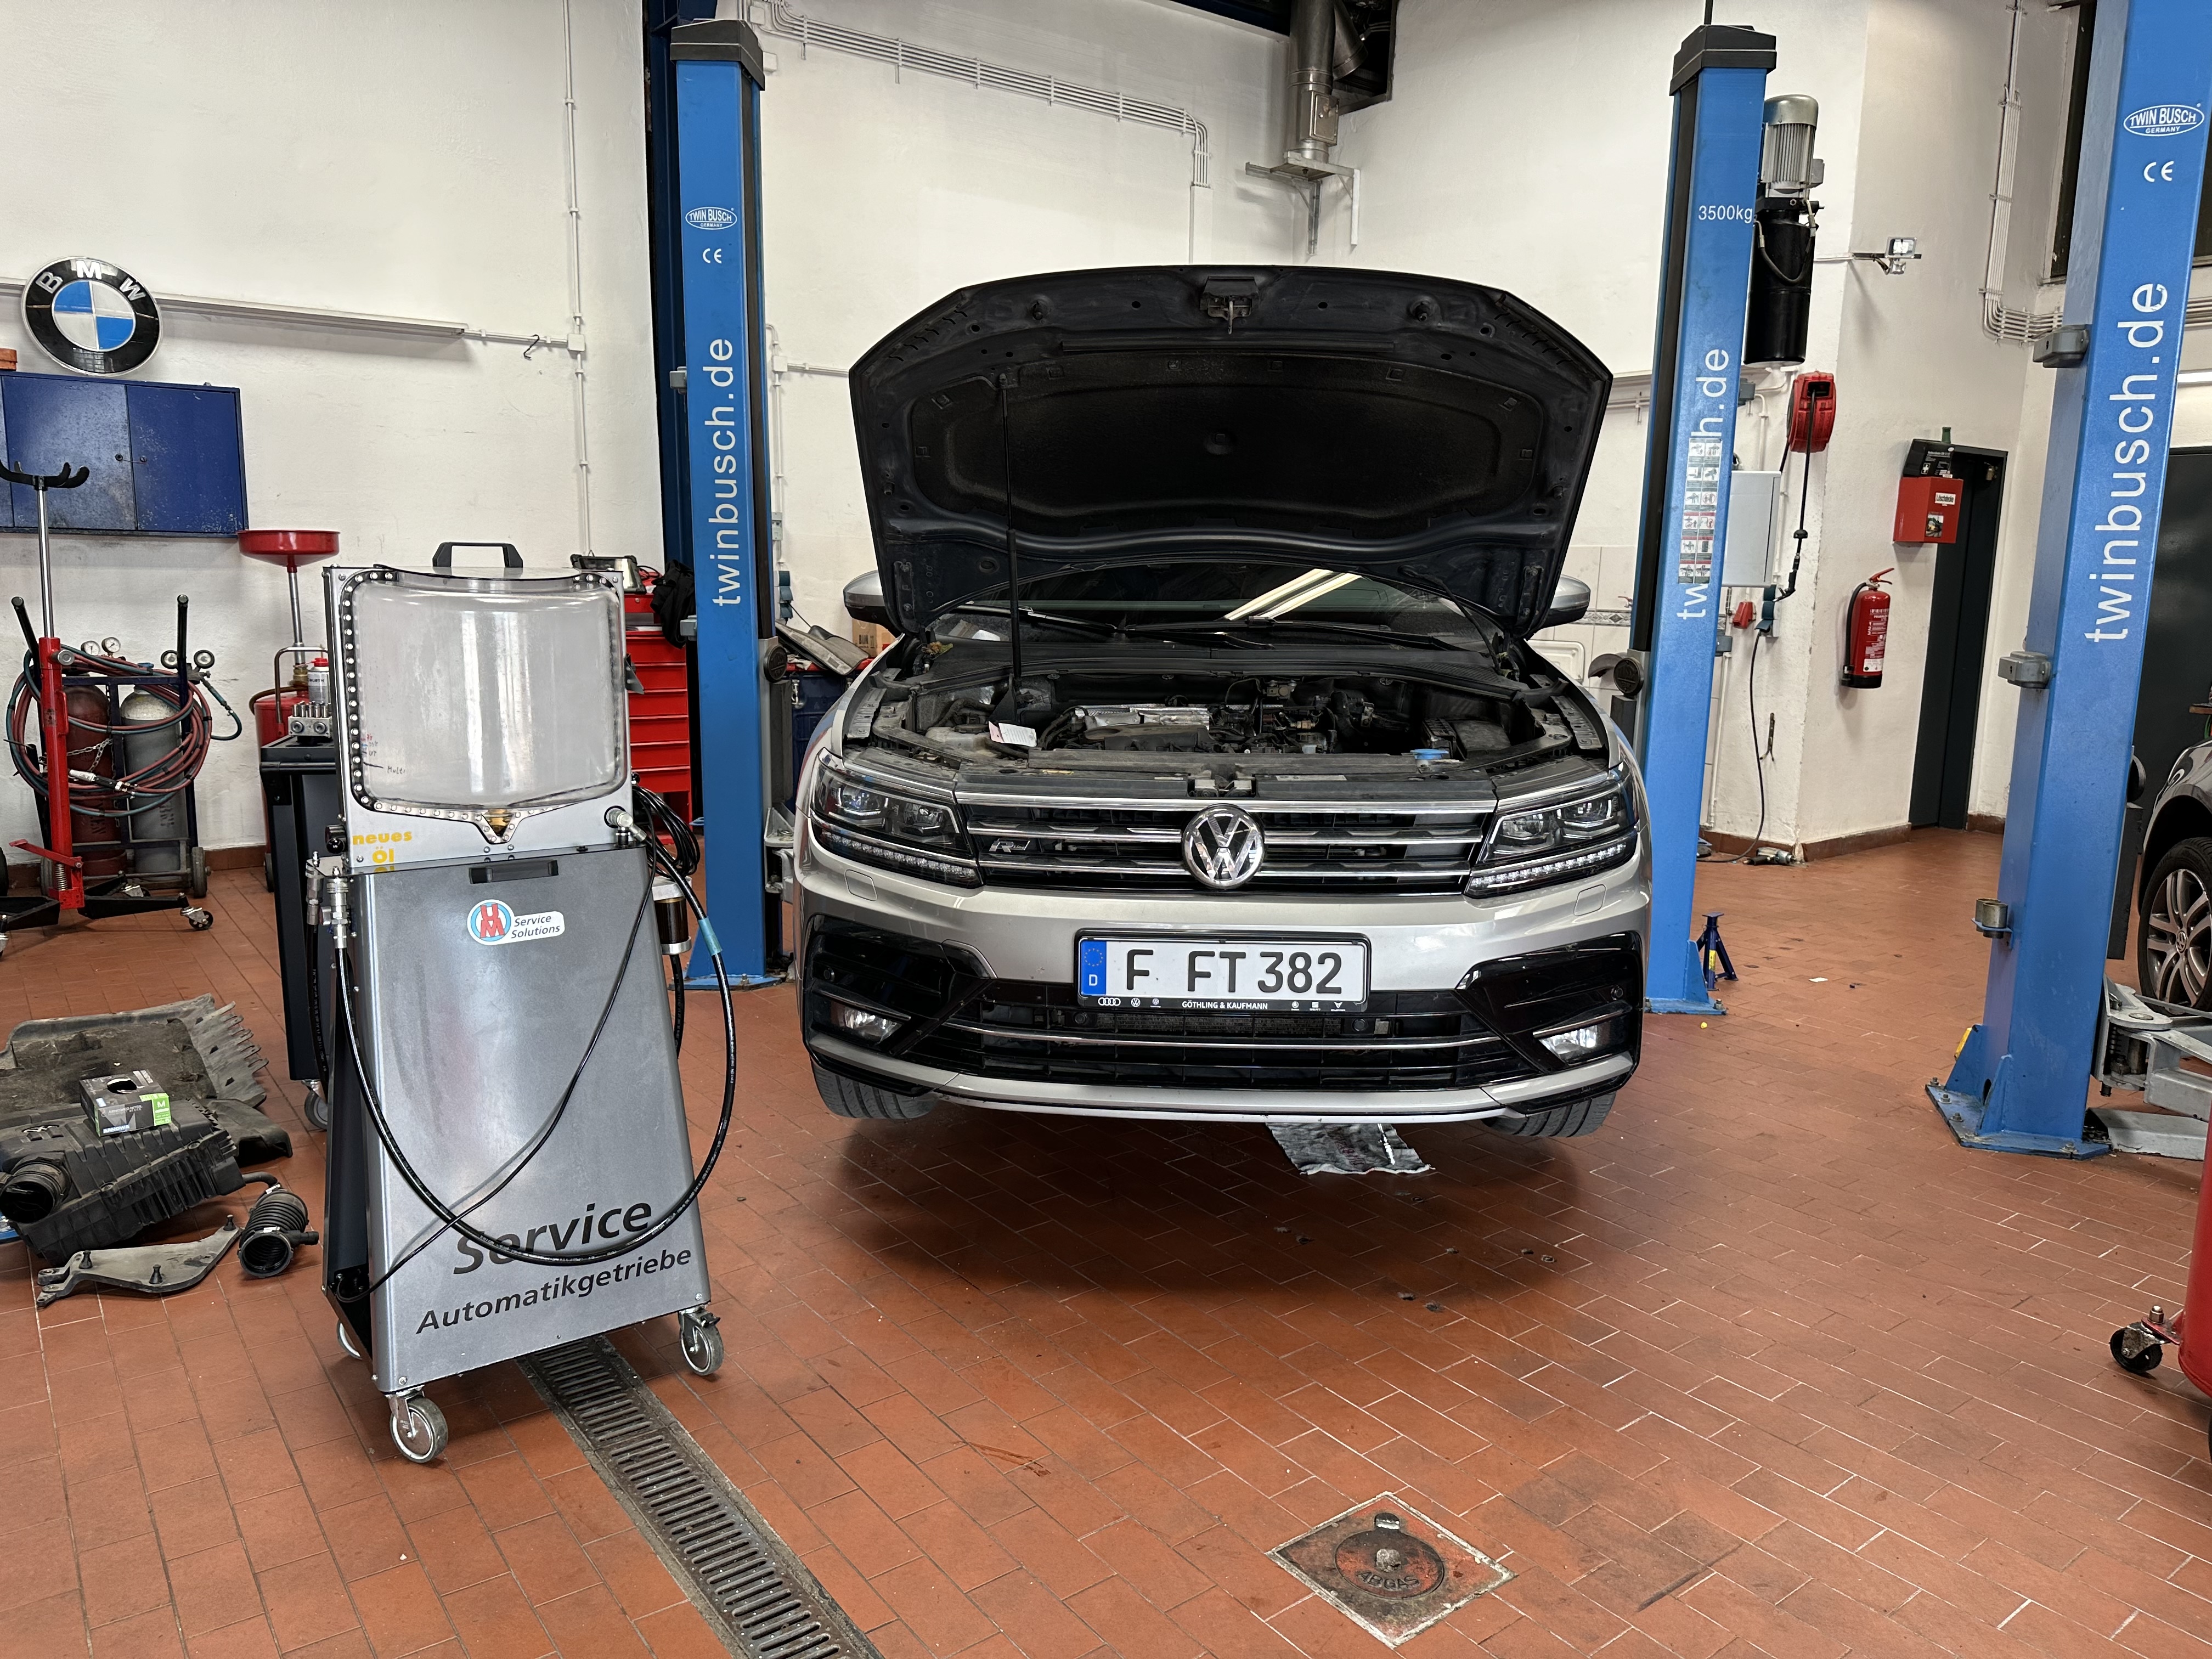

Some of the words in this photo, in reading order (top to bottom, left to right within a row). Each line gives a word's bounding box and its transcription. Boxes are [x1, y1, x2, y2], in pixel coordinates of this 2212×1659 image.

[2130, 109, 2157, 126] TWIN
[2159, 108, 2196, 124] BUSCH
[2143, 161, 2174, 183] CE
[689, 210, 706, 221] TWIN
[708, 209, 732, 221] BUSCH
[1698, 205, 1753, 223] 3500kg
[702, 248, 722, 263] CE
[35, 260, 146, 301] BMW
[2084, 283, 2168, 642] twinbusch.de
[703, 338, 741, 606] twinbusch.de
[352, 831, 413, 845] neues
[989, 840, 1014, 853] R
[372, 846, 394, 864] Öl
[514, 915, 551, 927] Service
[511, 925, 561, 939] Solutions
[1126, 949, 1154, 990] F
[1088, 974, 1098, 986] D
[1182, 1000, 1218, 1009] GÖTHLING
[453, 1202, 652, 1274] Service
[415, 1249, 691, 1335] Automatikgetriebe
[1357, 1570, 1420, 1591] ABGAS
